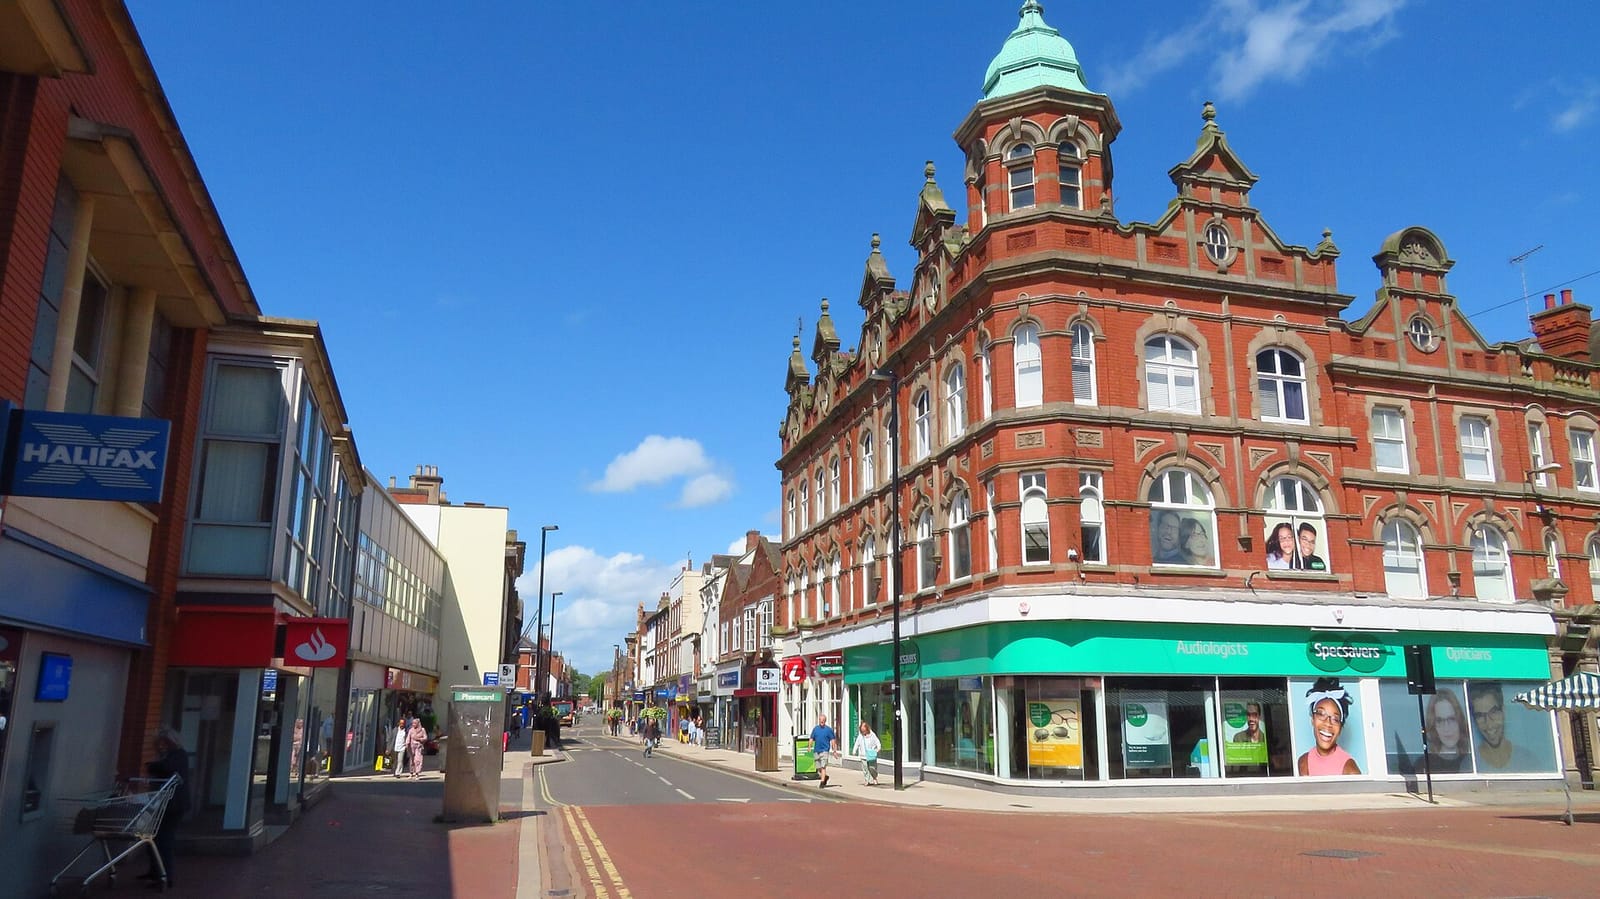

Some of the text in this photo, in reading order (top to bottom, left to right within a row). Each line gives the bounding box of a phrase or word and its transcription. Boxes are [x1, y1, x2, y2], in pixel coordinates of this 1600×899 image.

[23, 443, 157, 470] HALIFAX
[1176, 640, 1249, 659] Audiologists
[1313, 643, 1380, 661] Specsavers
[1446, 646, 1492, 662] Opticians
